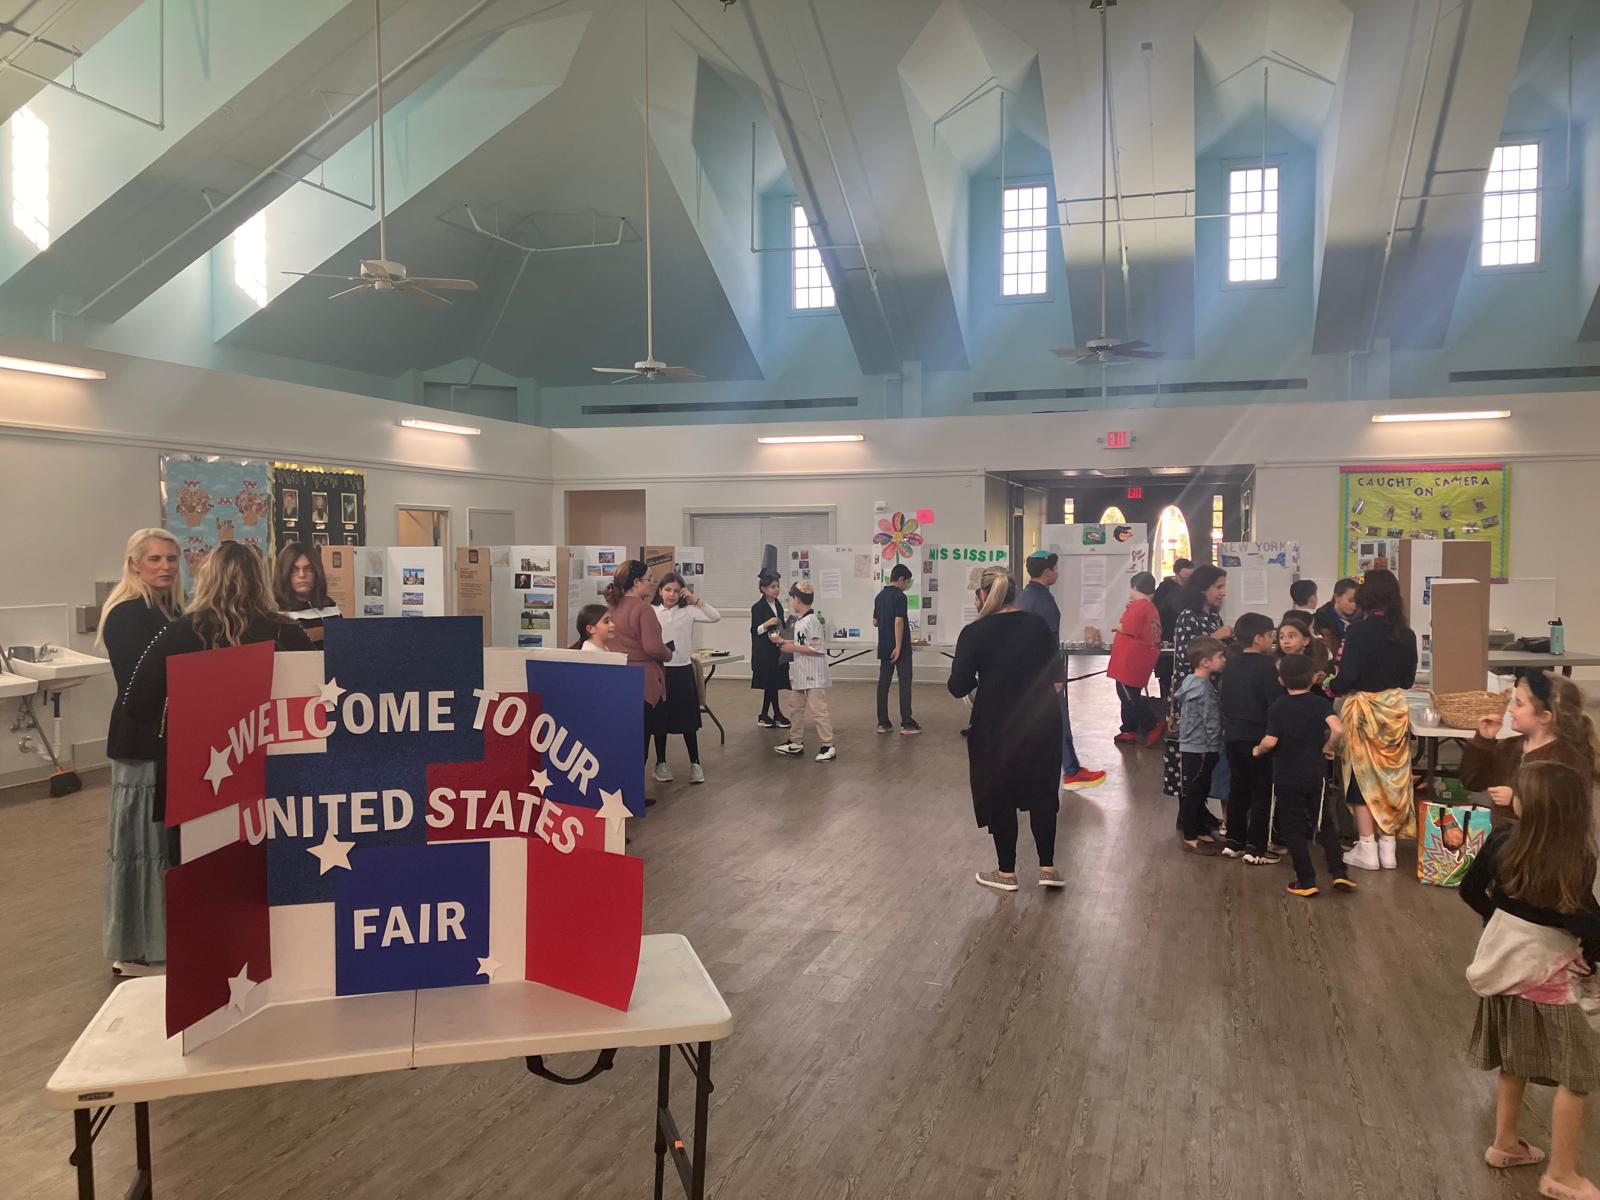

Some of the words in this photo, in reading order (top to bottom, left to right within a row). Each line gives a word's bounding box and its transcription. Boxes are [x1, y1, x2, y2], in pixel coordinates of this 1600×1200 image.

[1107, 431, 1127, 448] EXIT
[1358, 477, 1414, 487] CAUGHT
[1414, 487, 1433, 496] ON
[1435, 475, 1490, 487] CAMERA
[1221, 542, 1248, 553] NEW
[1255, 541, 1286, 552] YORK
[227, 690, 455, 765] WELCOME
[472, 688, 527, 736] TO
[529, 713, 600, 796] OUR
[243, 788, 414, 846] UNITED
[424, 787, 584, 854] STATES
[353, 901, 467, 950] FAIR
